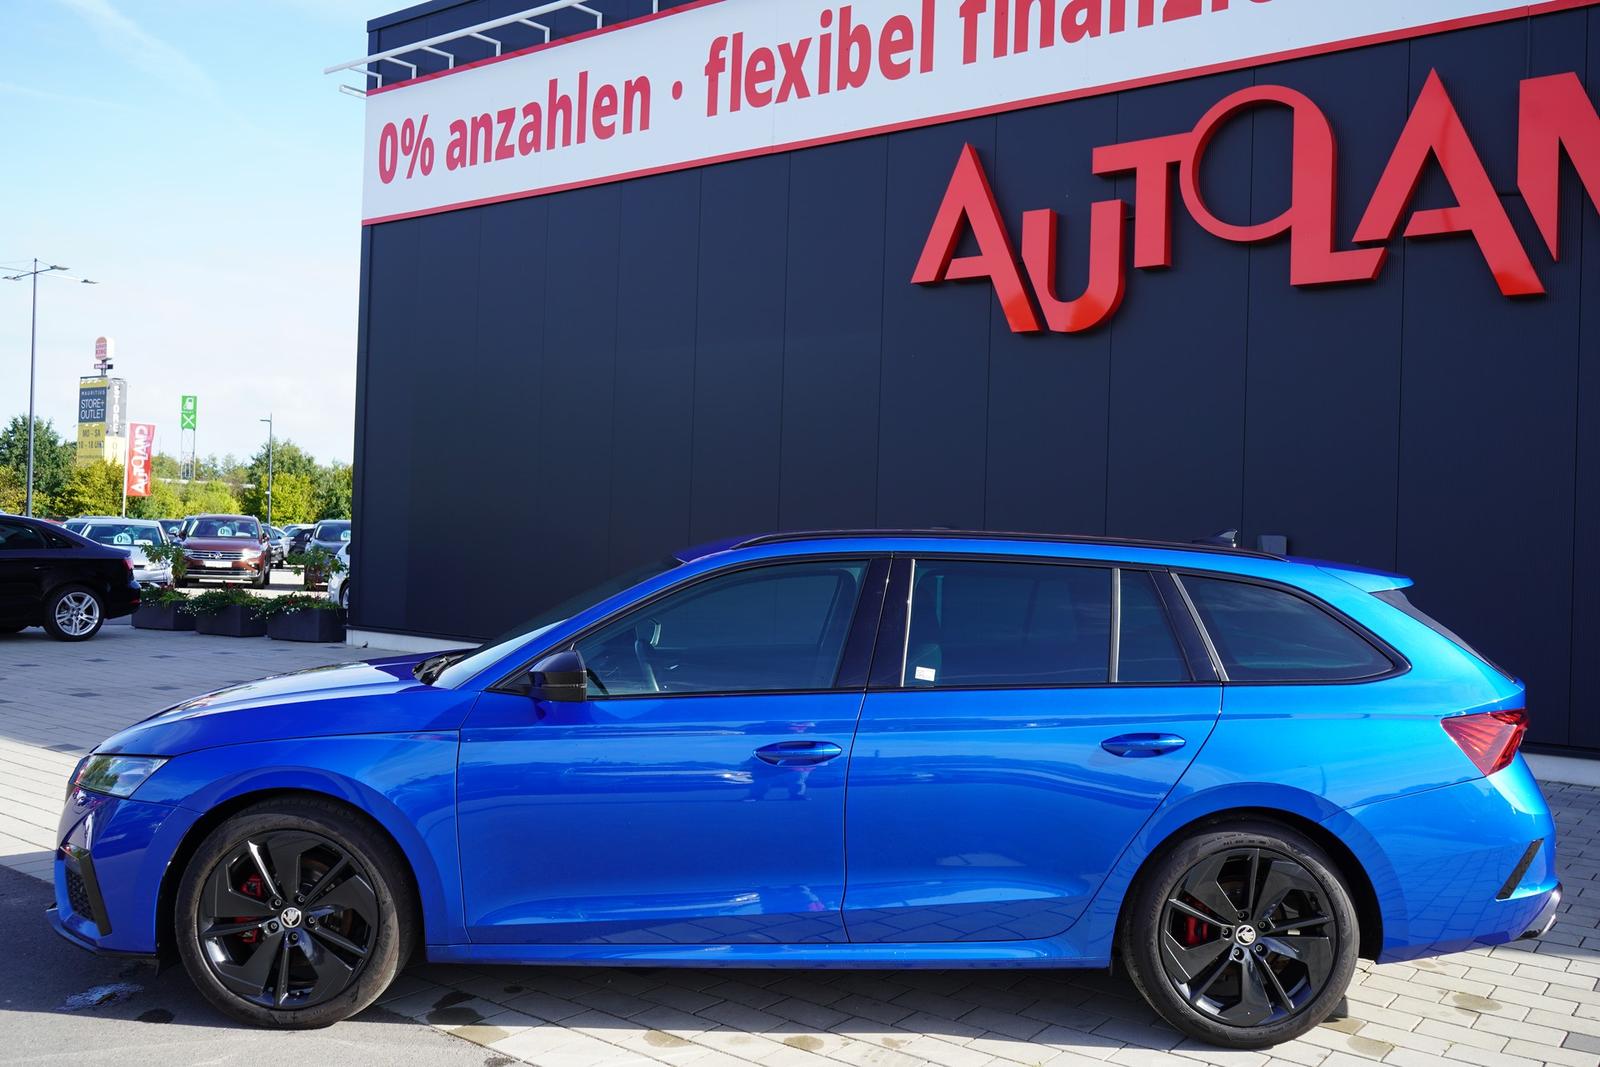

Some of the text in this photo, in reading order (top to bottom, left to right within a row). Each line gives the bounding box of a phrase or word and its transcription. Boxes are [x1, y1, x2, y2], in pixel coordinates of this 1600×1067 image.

[379, 114, 435, 184] 0%
[446, 71, 650, 171] anzahlen
[705, 0, 936, 117] flexibel
[80, 408, 104, 420] OUTLET
